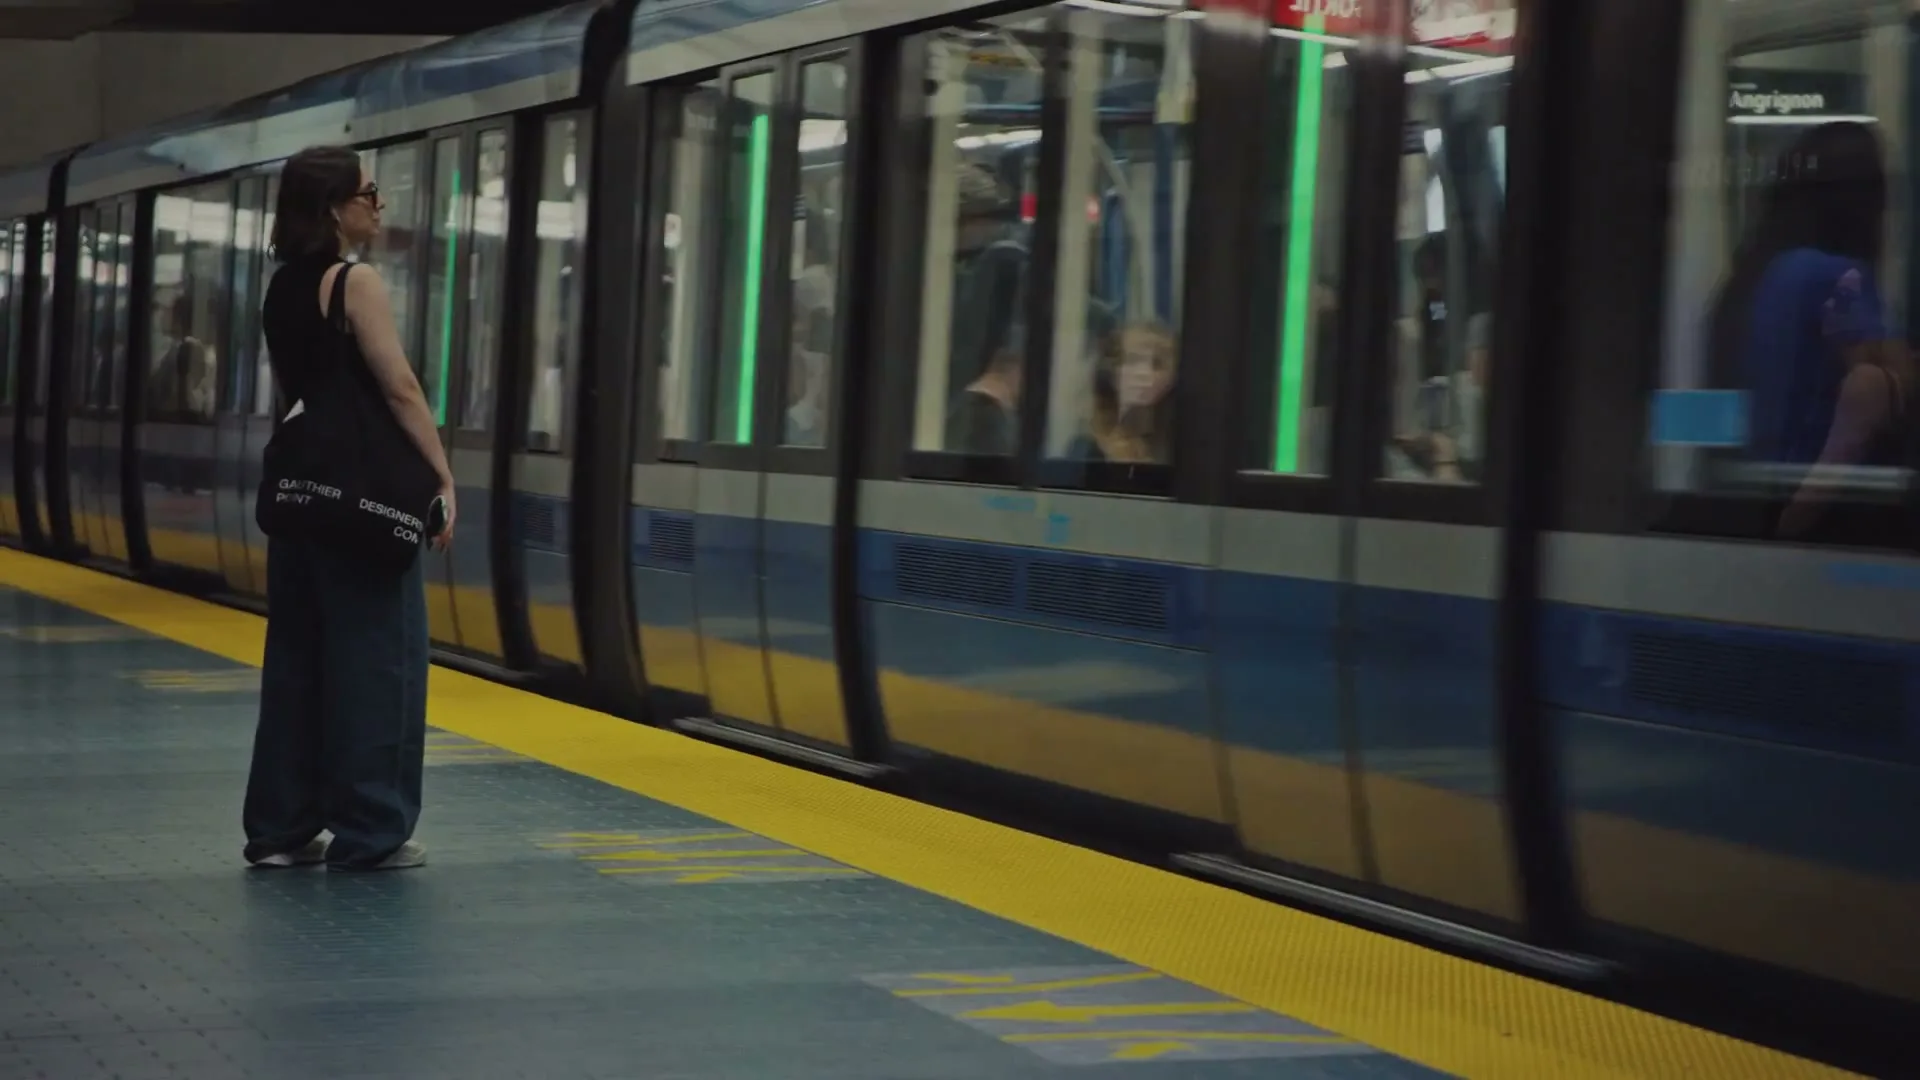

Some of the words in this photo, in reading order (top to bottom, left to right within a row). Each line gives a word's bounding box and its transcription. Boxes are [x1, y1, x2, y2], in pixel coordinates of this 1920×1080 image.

[1729, 90, 1825, 114] Angrignon
[275, 492, 312, 505] PNT
[279, 478, 342, 500] GAUTHIER
